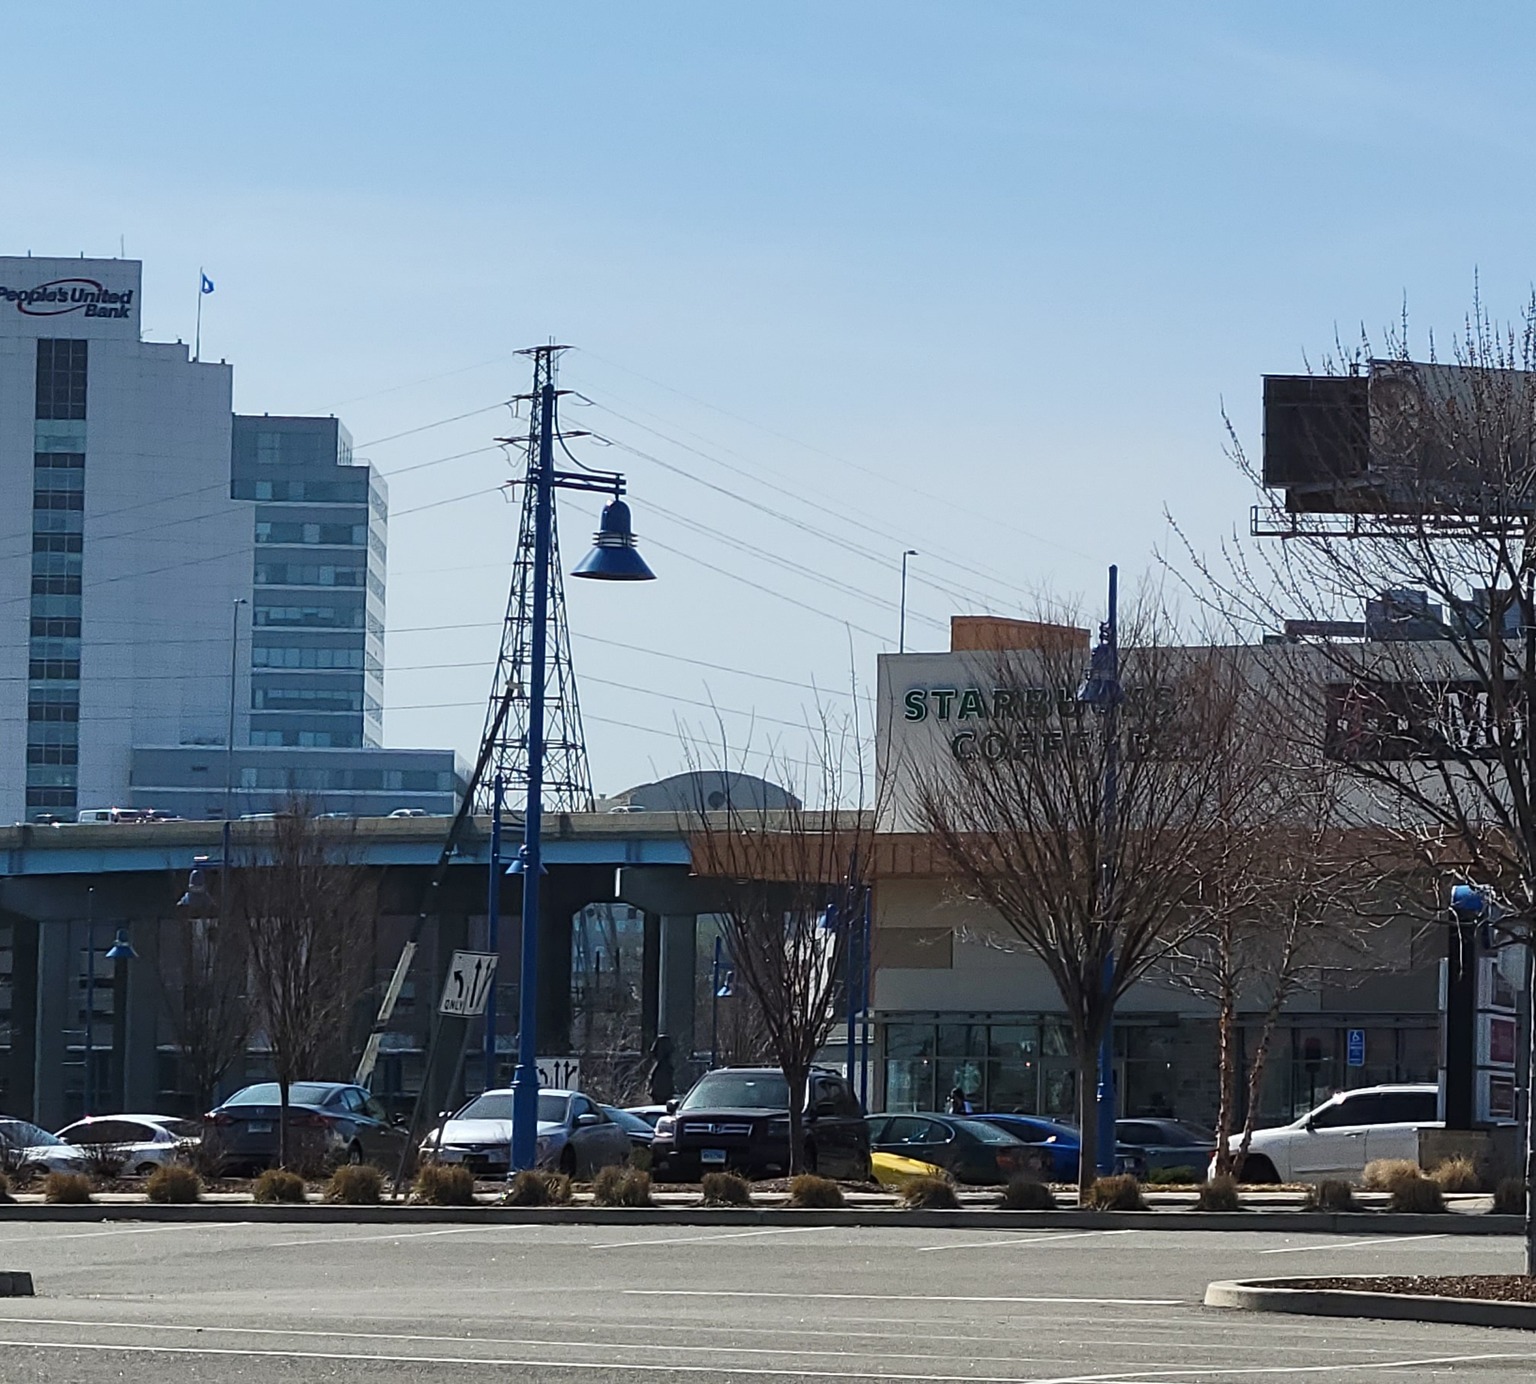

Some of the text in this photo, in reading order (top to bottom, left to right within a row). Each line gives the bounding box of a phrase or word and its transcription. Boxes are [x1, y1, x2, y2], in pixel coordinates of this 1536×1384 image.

[0, 286, 134, 305] People's United
[84, 303, 131, 318] Bank
[445, 999, 463, 1010] ONLY
